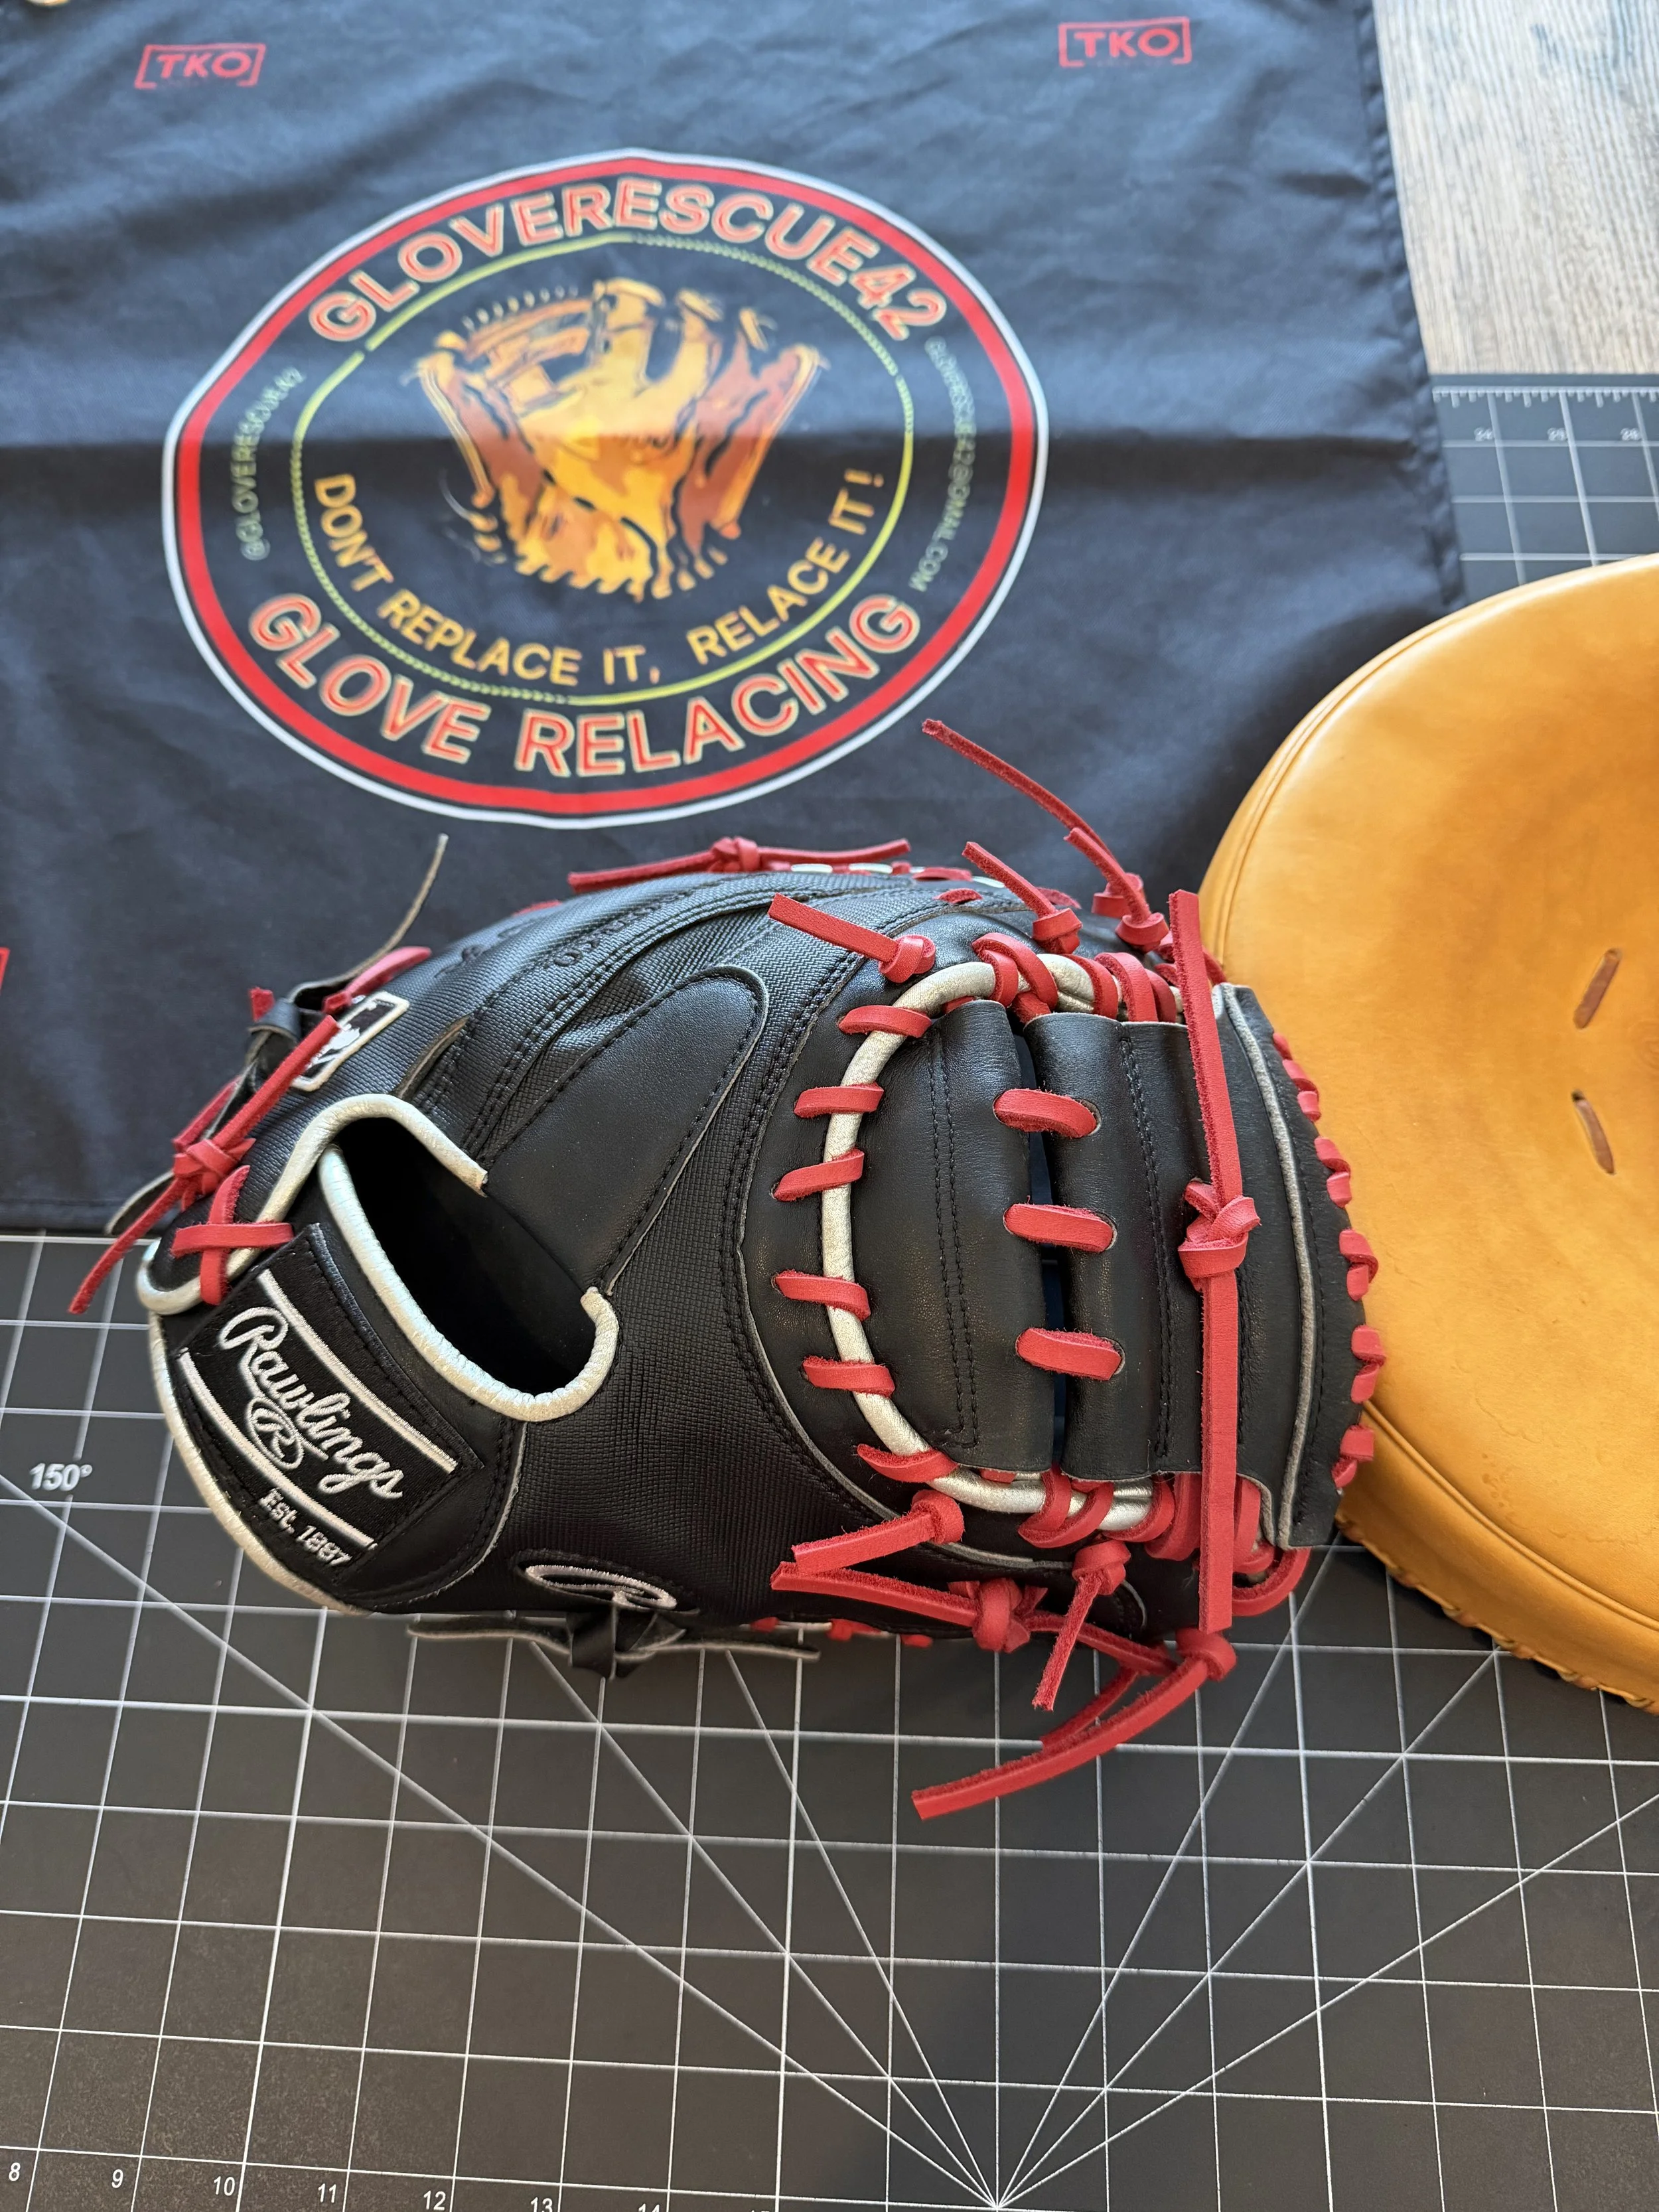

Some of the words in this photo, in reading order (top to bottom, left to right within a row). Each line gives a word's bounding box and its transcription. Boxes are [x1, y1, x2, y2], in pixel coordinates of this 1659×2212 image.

[1073, 27, 1180, 58] TKO
[156, 50, 252, 79] TKO
[309, 177, 947, 341] GLOVERESCUE42
[314, 473, 394, 591] DON'T
[376, 589, 582, 686] REPLACE
[686, 538, 851, 664] RELACE
[248, 593, 492, 765] GLOVE
[514, 594, 920, 777] RELACING
[218, 1306, 405, 1499] Rawlings
[296, 1525, 353, 1566] 1887
[8, 2162, 21, 2181] 8
[111, 2169, 124, 2189] 9
[213, 2176, 236, 2196] 10
[317, 2183, 337, 2203] 11
[423, 2190, 446, 2211] 12
[531, 2197, 553, 2212] 13
